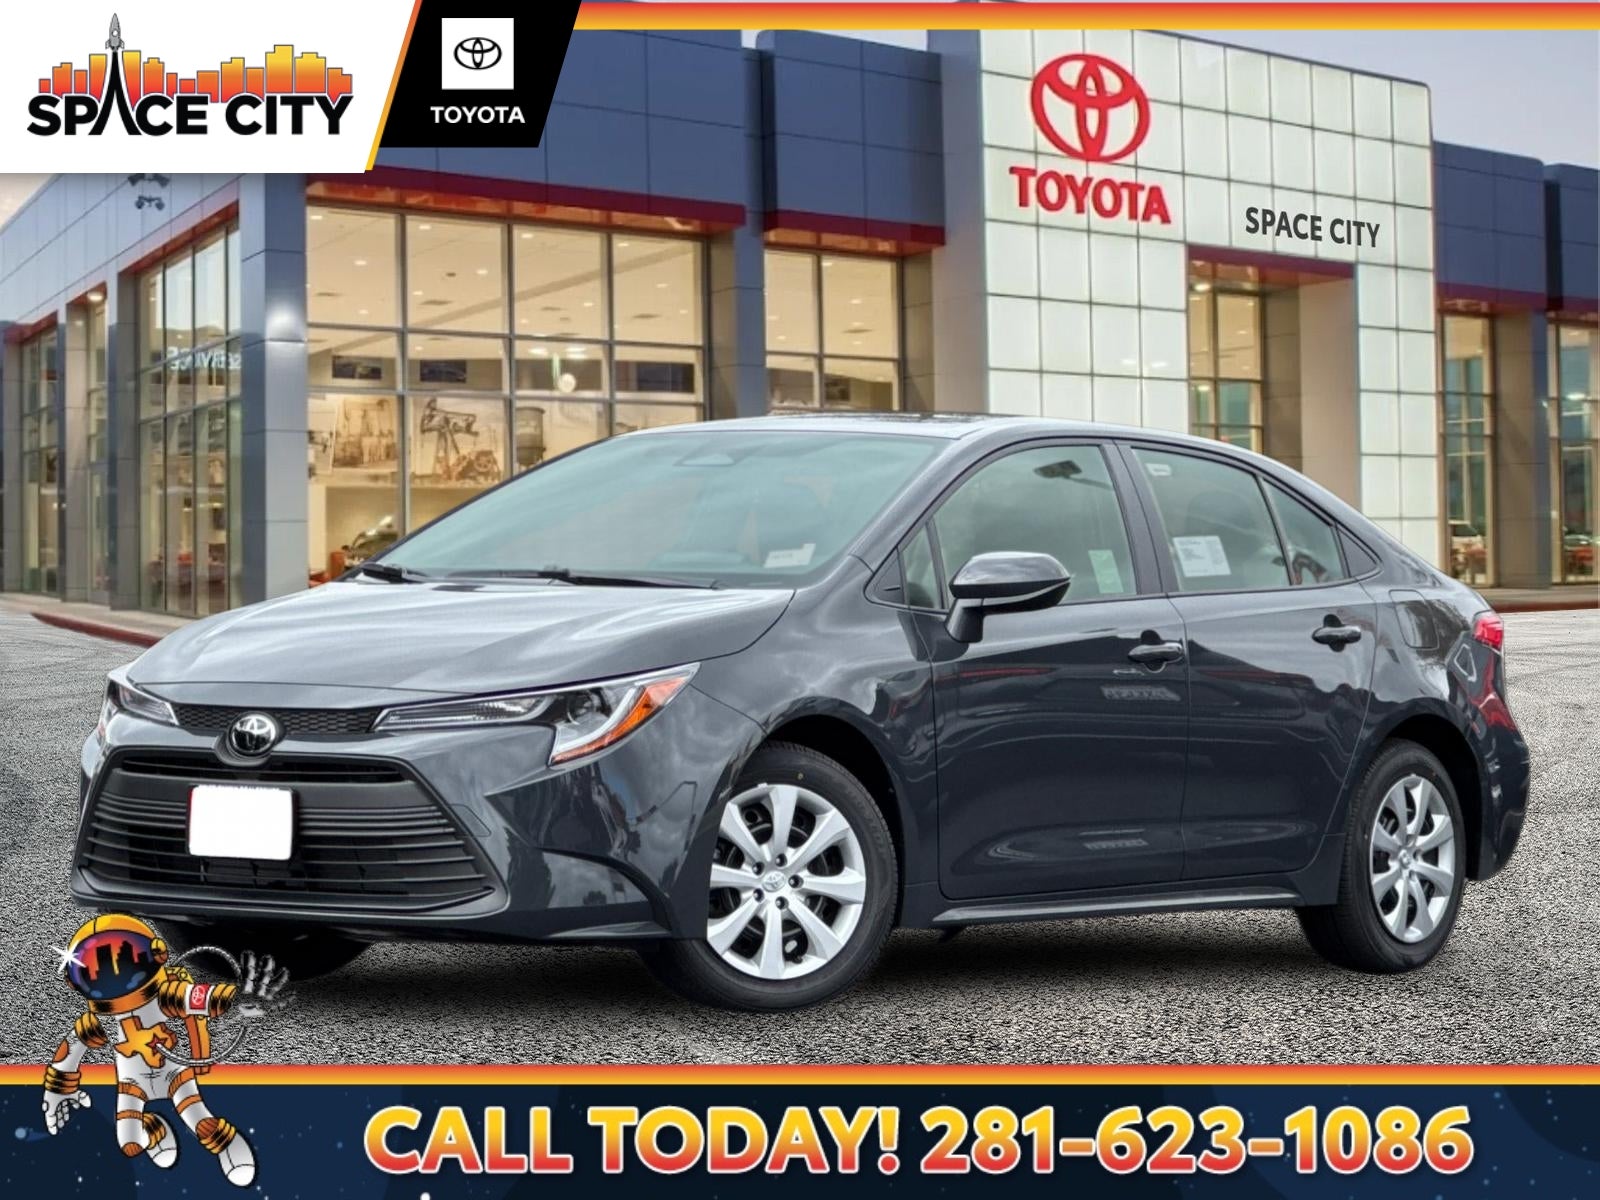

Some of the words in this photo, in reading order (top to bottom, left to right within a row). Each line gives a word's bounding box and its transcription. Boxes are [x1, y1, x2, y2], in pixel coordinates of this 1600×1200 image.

[1009, 165, 1171, 225] TOYOTA
[1245, 206, 1323, 242] SPACE
[1329, 217, 1381, 248] CITY
